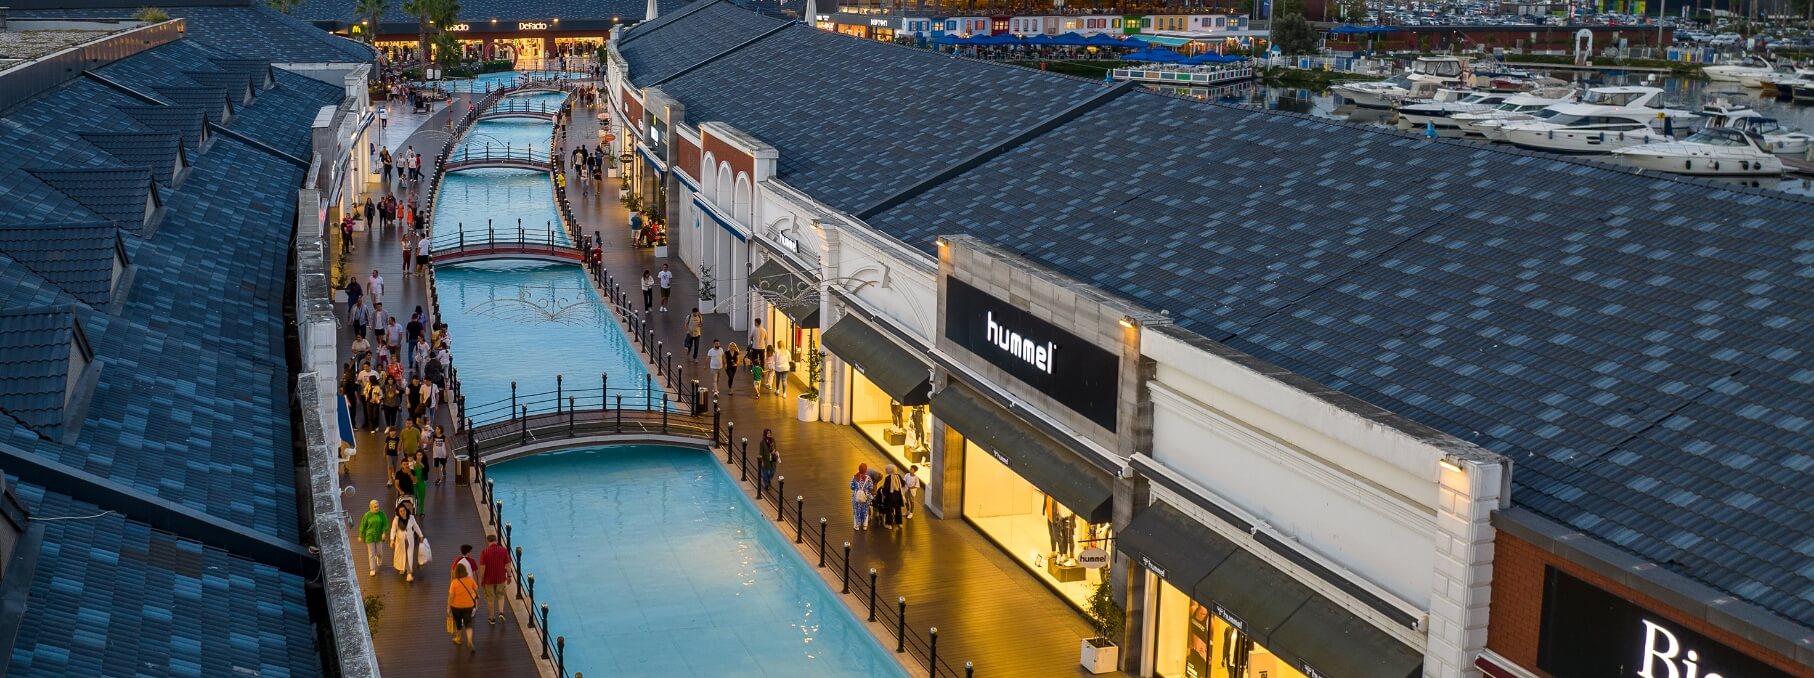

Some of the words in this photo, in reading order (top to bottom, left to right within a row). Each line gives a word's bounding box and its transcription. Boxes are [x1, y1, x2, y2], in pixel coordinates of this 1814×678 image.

[519, 22, 547, 30] DeFacto
[987, 311, 1053, 375] hummel
[1080, 554, 1107, 563] hummel
